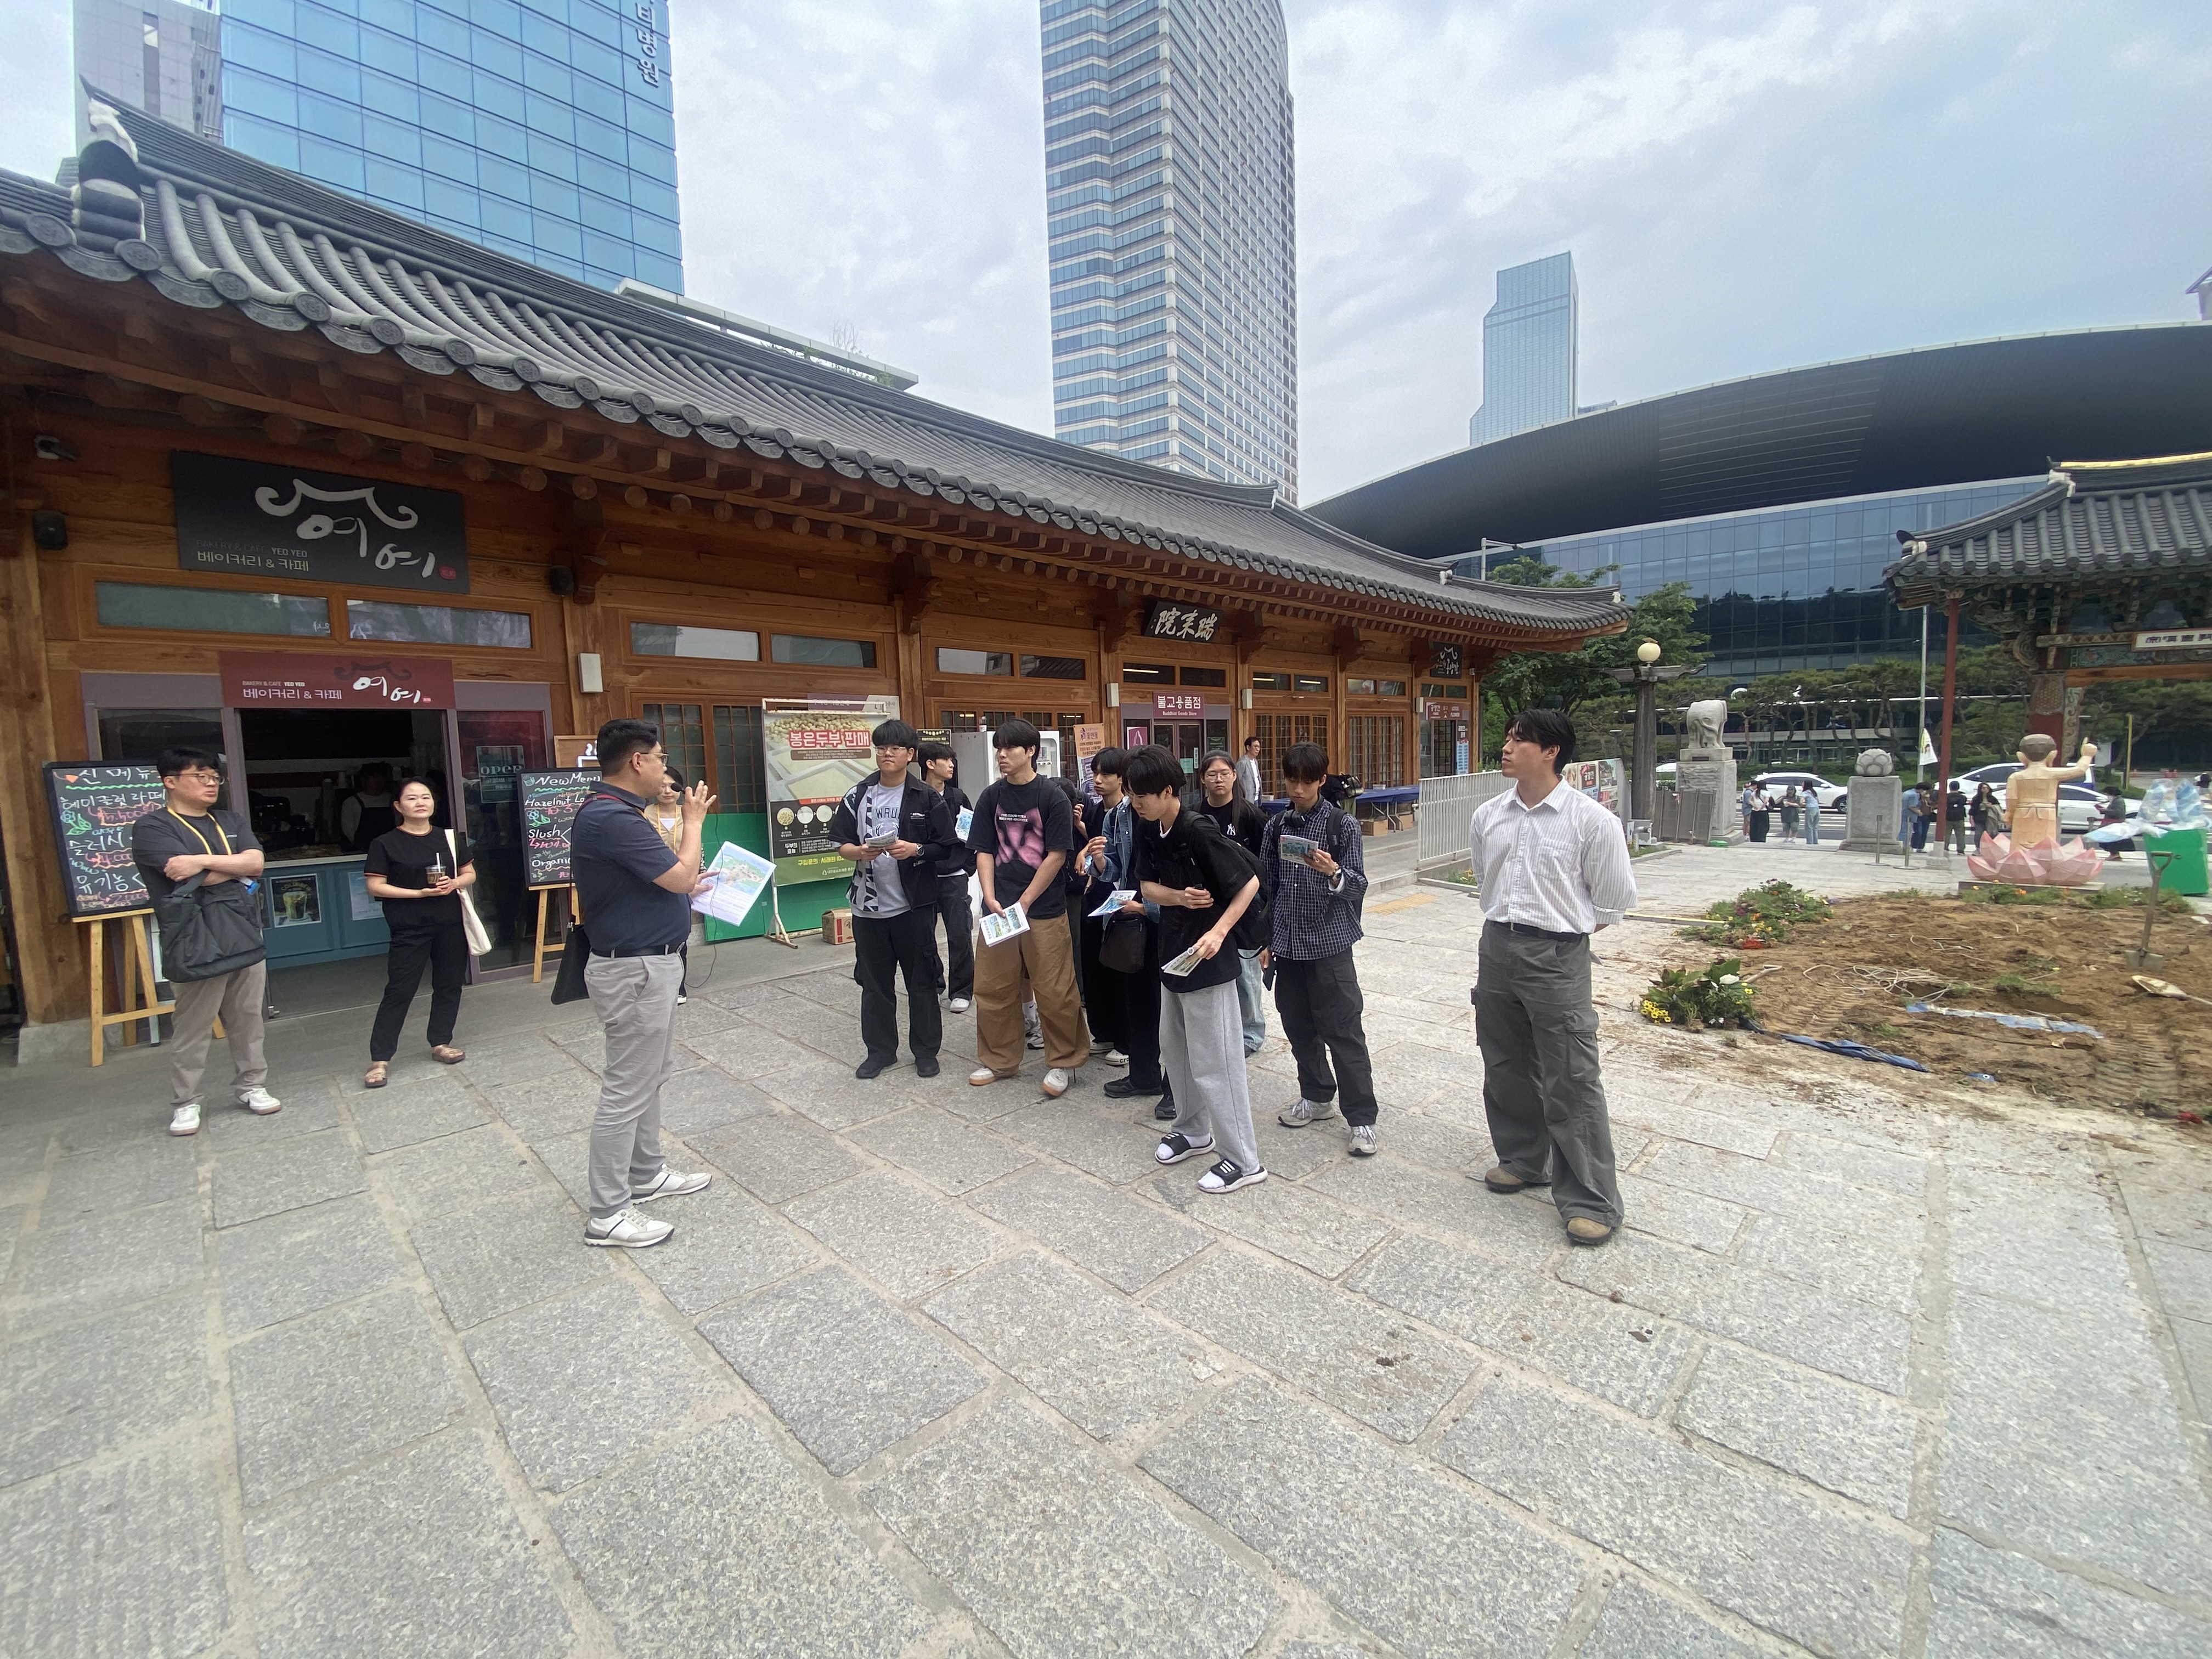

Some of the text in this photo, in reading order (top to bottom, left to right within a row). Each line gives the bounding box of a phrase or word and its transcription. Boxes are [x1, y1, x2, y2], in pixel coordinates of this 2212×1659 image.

[197, 551, 309, 572] 베이커리 & 카페
[243, 688, 342, 699] 베이커리 & 카페
[1158, 696, 1200, 709] 불교용품점
[790, 731, 870, 747] 봉은두부 판매
[78, 768, 151, 785] 신 메뉴
[535, 772, 601, 786] New Menu
[131, 789, 166, 805] 라떼
[524, 796, 572, 807] Hazelnut
[528, 824, 560, 838] Slush
[69, 832, 125, 856] 슬러시
[798, 858, 817, 866] 구입문의
[76, 873, 129, 894] 유기농
